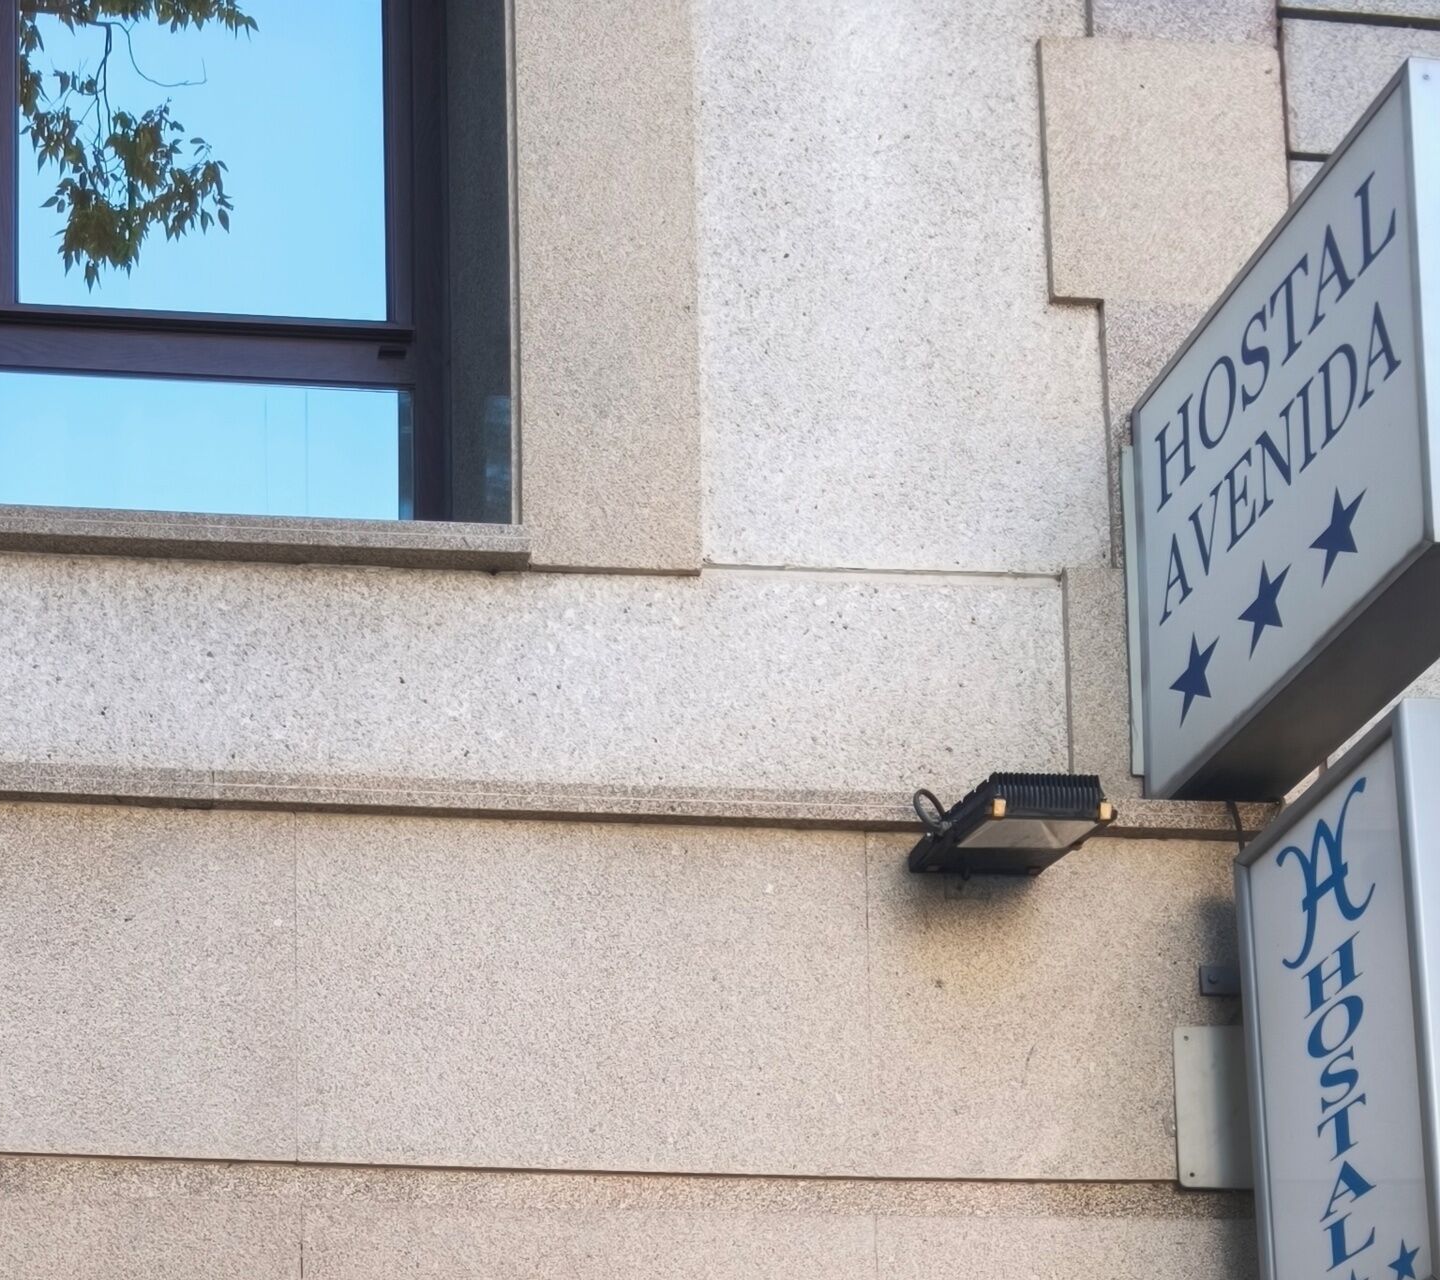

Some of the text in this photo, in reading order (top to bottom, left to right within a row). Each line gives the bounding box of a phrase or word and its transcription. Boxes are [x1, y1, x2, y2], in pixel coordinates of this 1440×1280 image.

[1154, 170, 1398, 513] HOSTAL
[1159, 301, 1402, 626] AVENIDA
[1303, 931, 1377, 1272] HOSTAL
